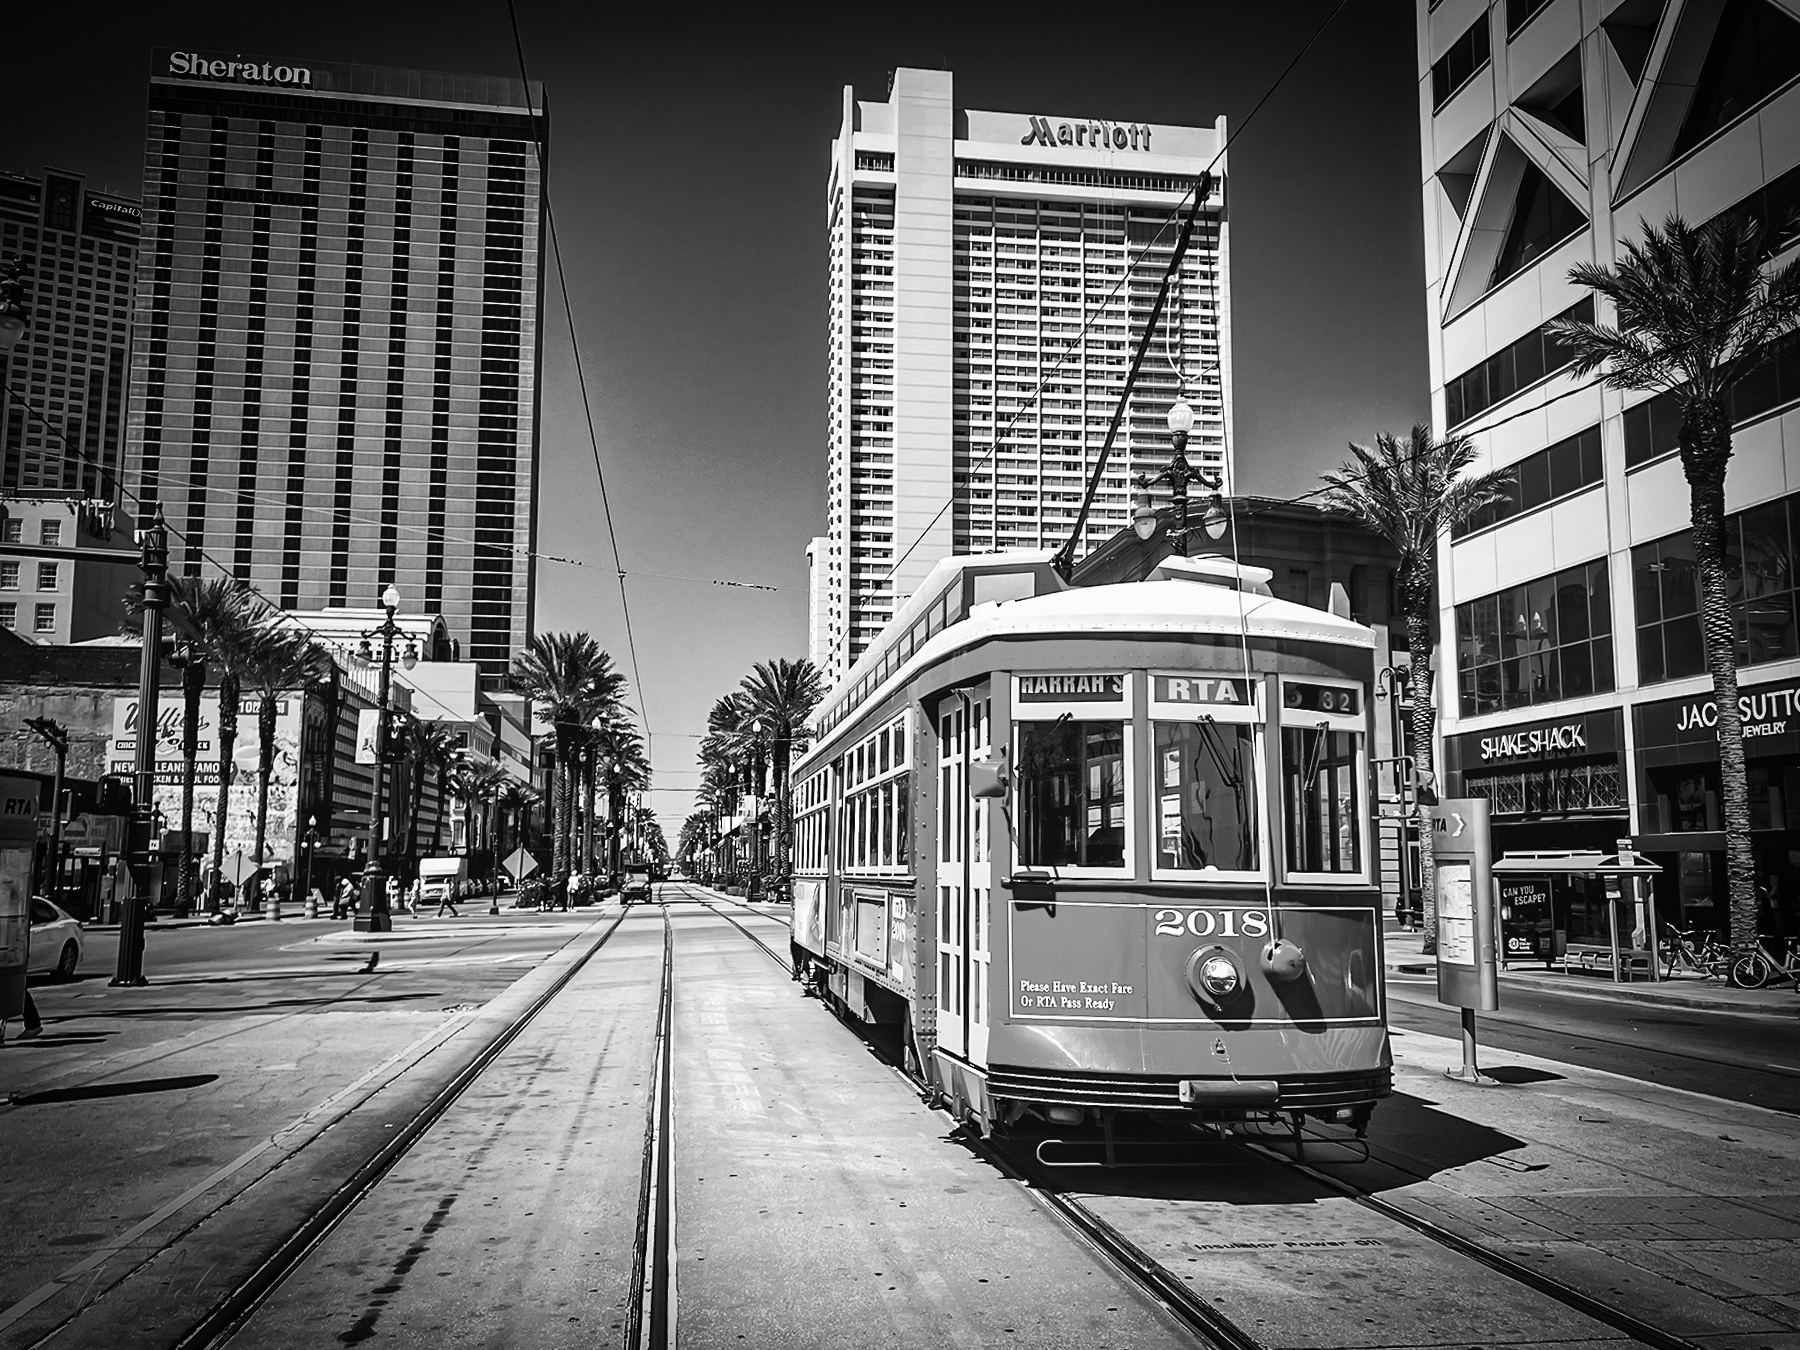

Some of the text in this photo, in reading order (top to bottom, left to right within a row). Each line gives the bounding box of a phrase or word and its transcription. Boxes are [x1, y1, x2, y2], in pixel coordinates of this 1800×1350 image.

[169, 51, 311, 85] Sheraton
[1021, 115, 1152, 152] Marriott
[91, 199, 142, 218] CapitalO
[1021, 676, 1124, 693] HARRAH'S
[1168, 679, 1239, 702] RTA
[1323, 690, 1350, 712] 32
[1677, 702, 1718, 731] JAC
[1742, 721, 1786, 738] JEWELRY
[1480, 724, 1586, 760] SHAKE SHACK
[203, 775, 220, 784] FOO
[4, 798, 31, 815] RTA
[1503, 885, 1534, 897] CAN YOU
[1515, 893, 1546, 905] ESCAPE?
[1154, 909, 1268, 937] 2018
[1020, 980, 1133, 994] Please Have Exact Fare
[1020, 995, 1115, 1011] Or RTA Pass Ready
